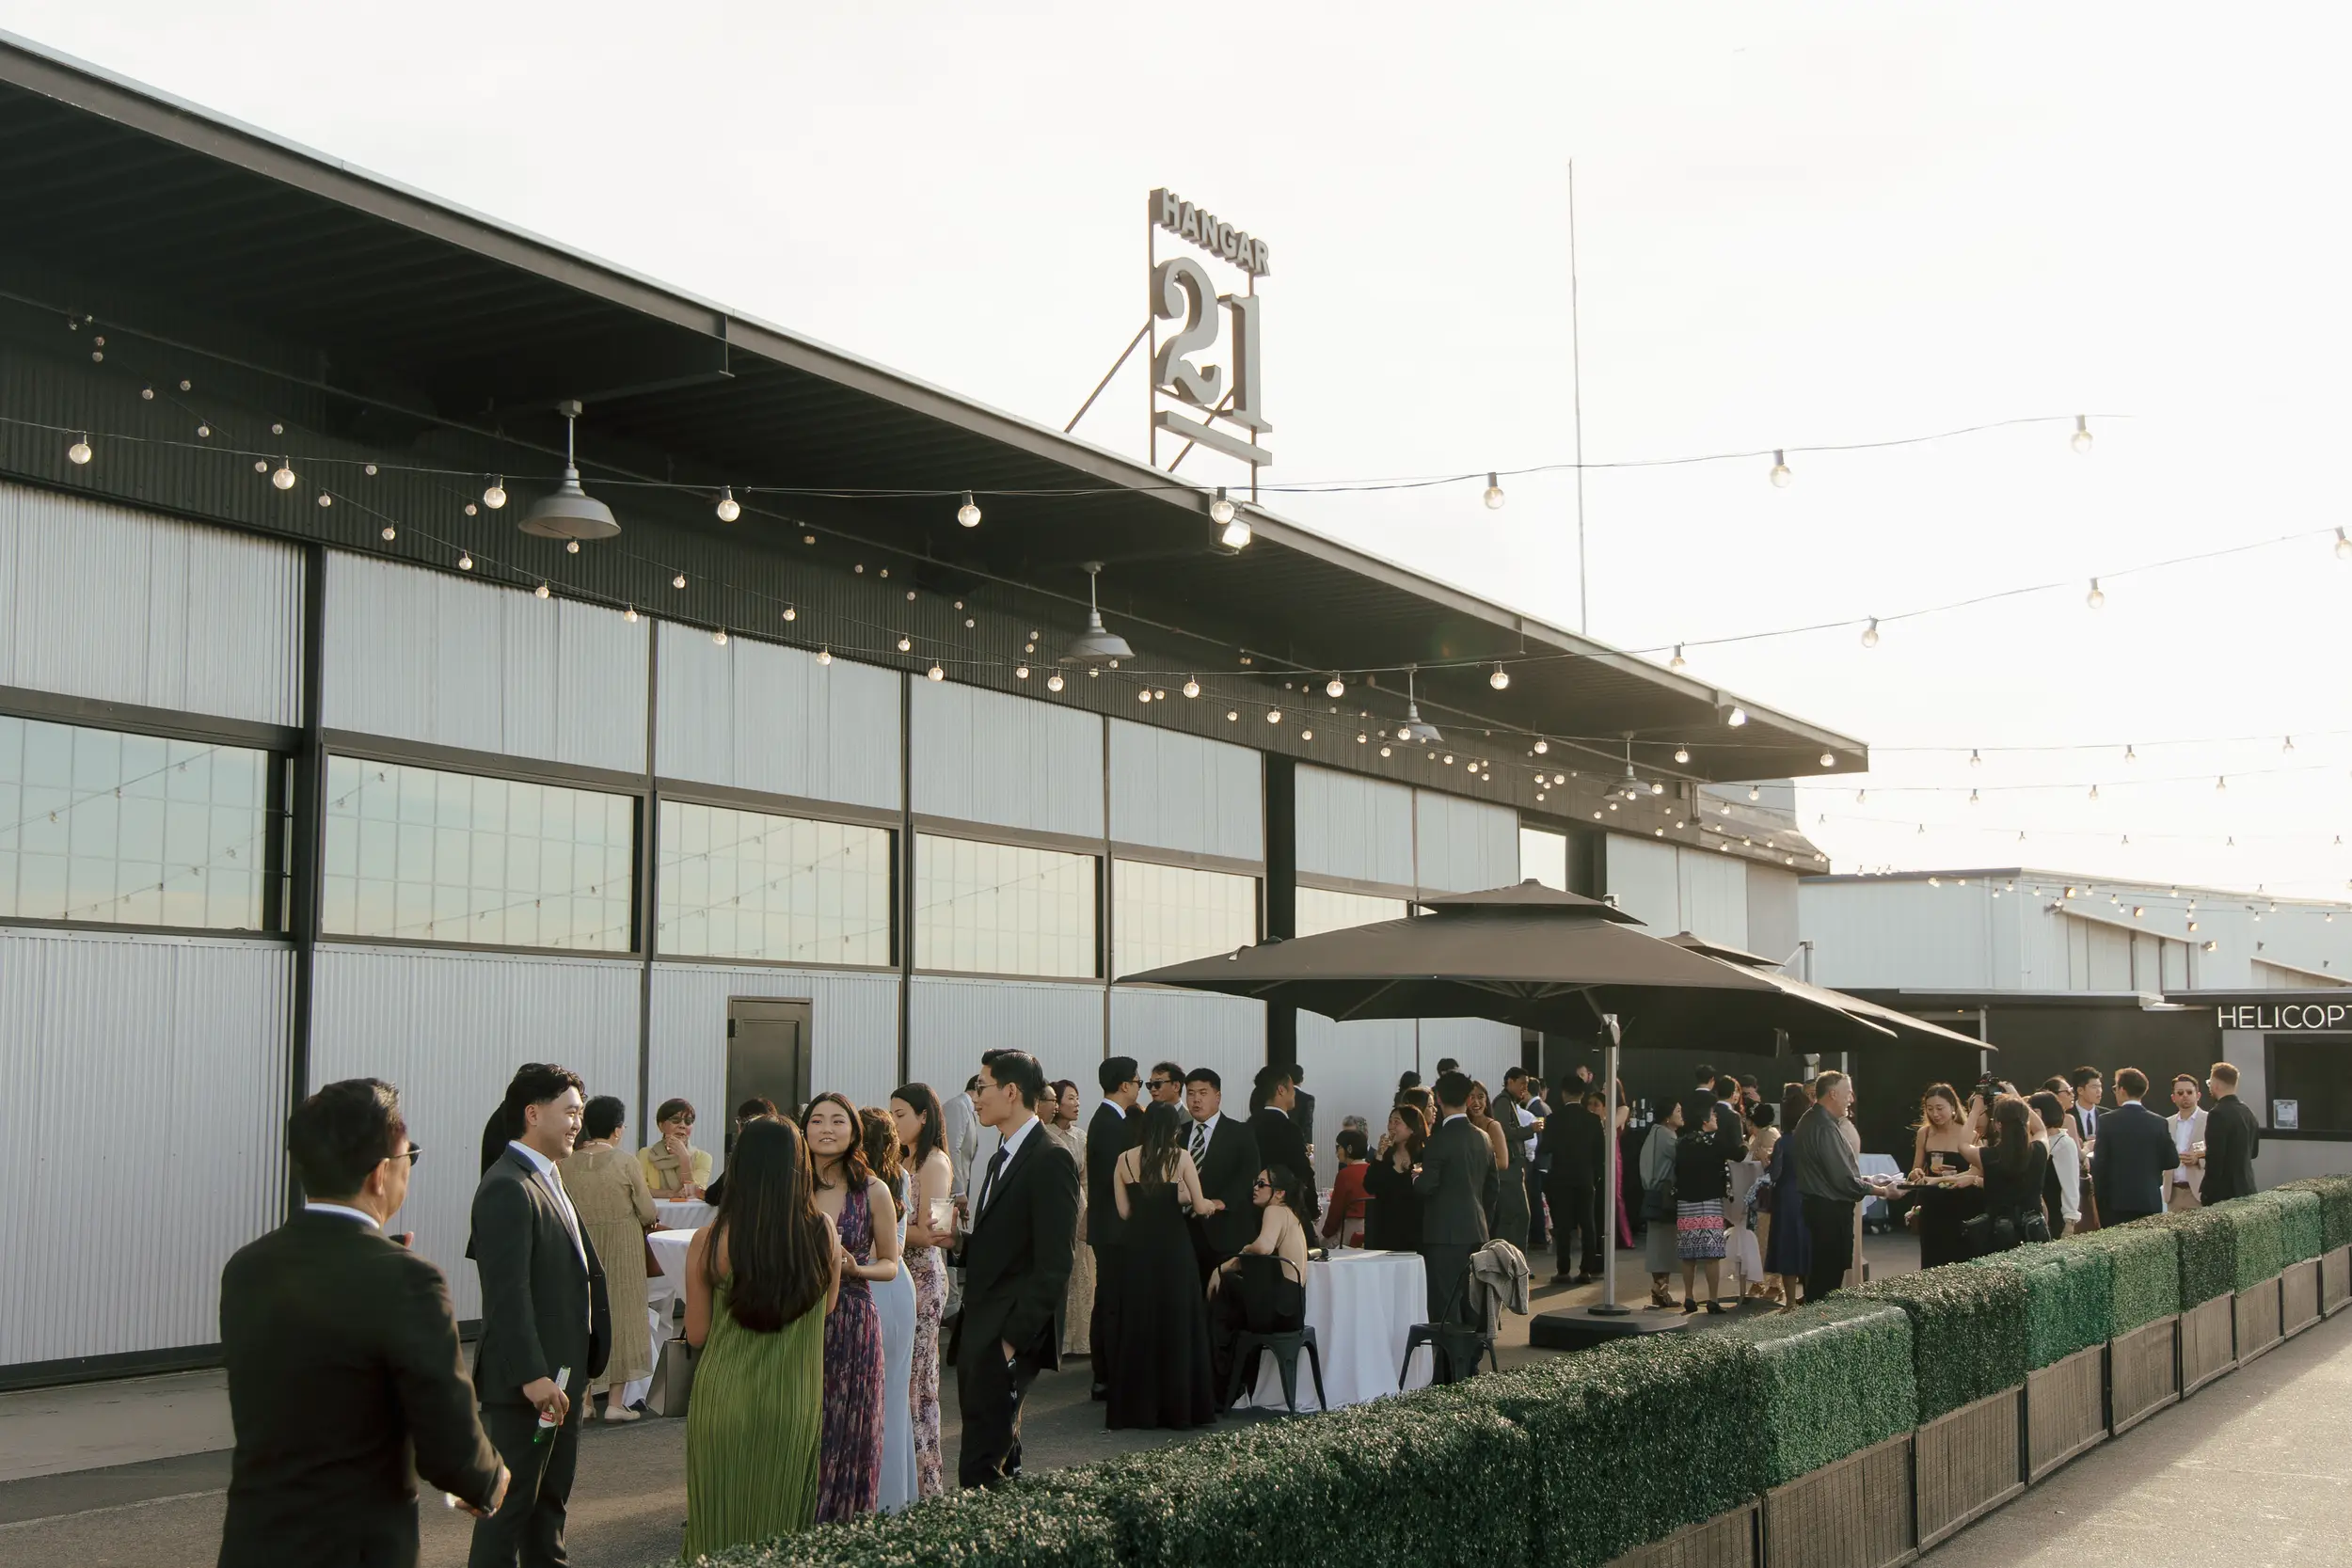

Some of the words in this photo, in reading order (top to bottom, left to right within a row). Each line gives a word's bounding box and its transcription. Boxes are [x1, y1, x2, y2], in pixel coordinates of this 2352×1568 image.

[1150, 187, 1270, 276] HANGAR
[1153, 257, 1272, 433] 21
[2217, 1005, 2352, 1029] HELICOP
